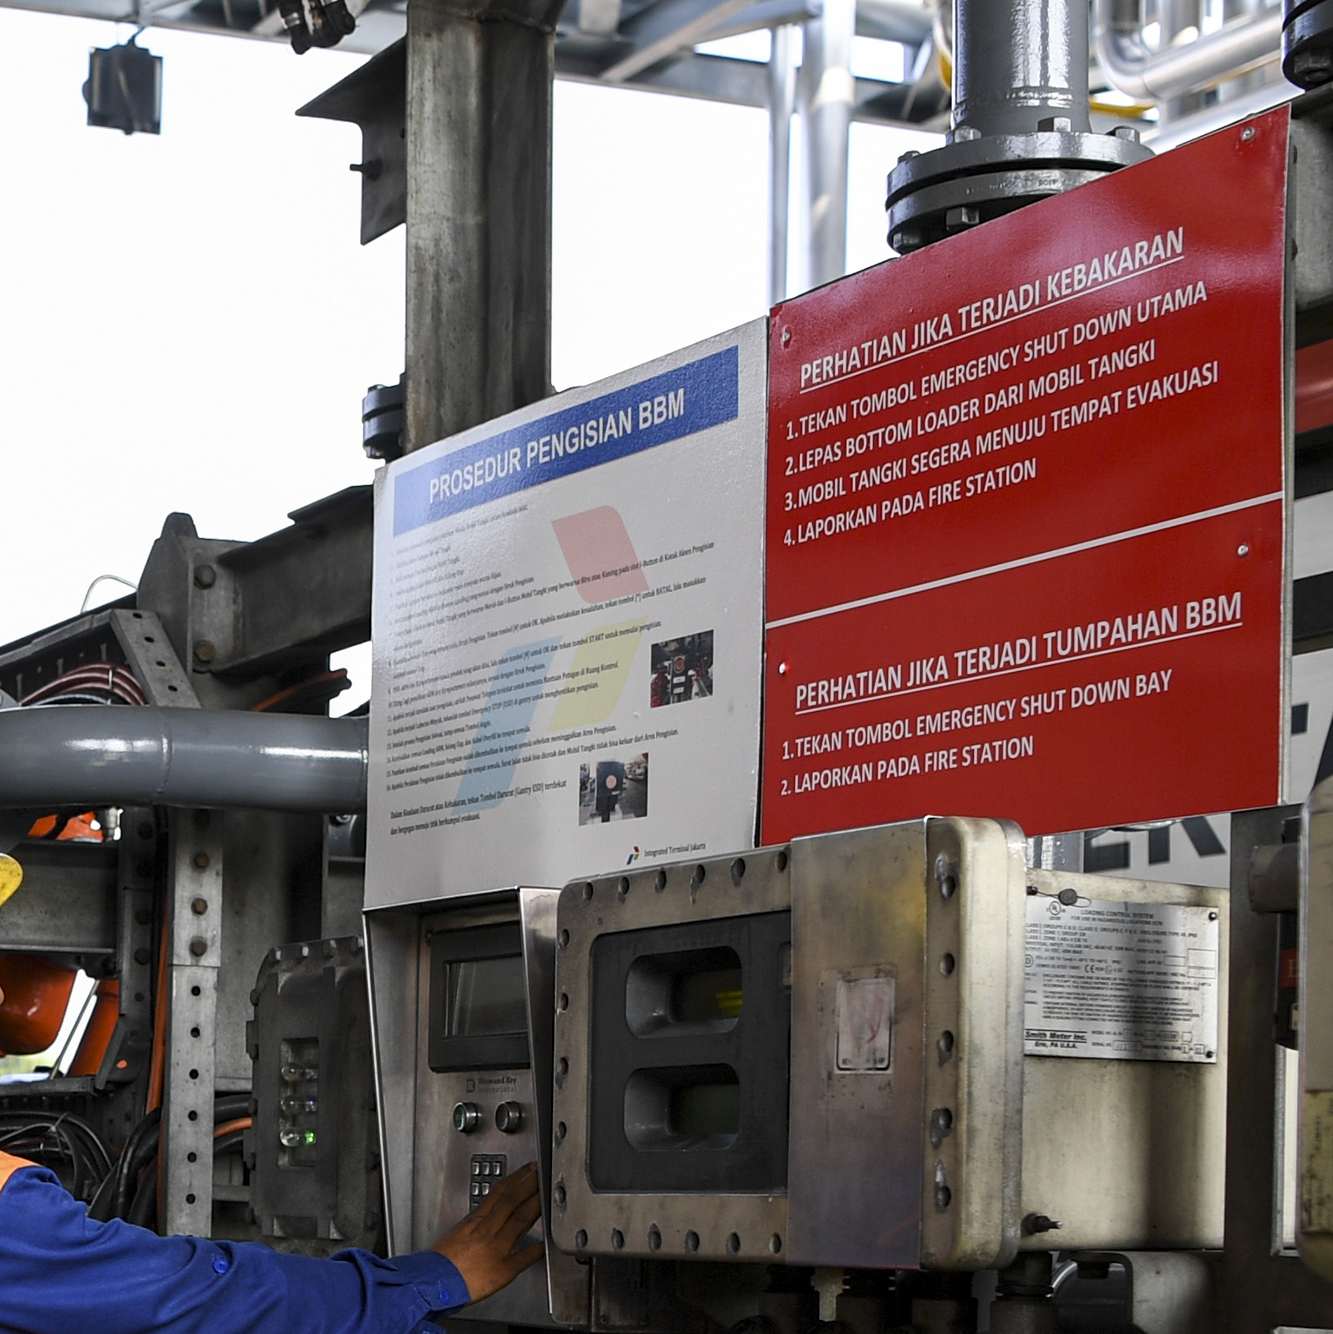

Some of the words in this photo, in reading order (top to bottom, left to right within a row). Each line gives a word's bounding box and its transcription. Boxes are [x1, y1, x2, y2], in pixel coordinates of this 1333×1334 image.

[799, 403, 847, 436] TEKAN
[850, 380, 917, 419] TOMBOL
[921, 344, 1020, 397] EMERGENCY
[1024, 328, 1069, 362] SHUT
[1073, 306, 1131, 345] DOWN
[1137, 280, 1207, 322] UTAMA
[801, 329, 906, 388] PERHATIAN
[911, 313, 953, 350] JIKA
[958, 280, 1040, 332] TERJADI
[1047, 226, 1183, 301] KEBAKARAN
[429, 446, 522, 504] PROSEDUR
[526, 407, 632, 468] PENGISIAN
[638, 388, 684, 430] BBM
[798, 477, 846, 508] MOBIL
[849, 458, 907, 492] TANGKI
[911, 439, 972, 475] SEGERA
[976, 415, 1046, 456] MENUJU
[1050, 390, 1122, 432] TEMPAT
[1127, 360, 1218, 409] EVAKUASI
[799, 441, 842, 472] LEPAS
[846, 419, 912, 458] BOTTOM
[917, 398, 980, 436] LOADER
[984, 383, 1023, 414] DARI
[1028, 364, 1084, 400] MOBIL
[1088, 339, 1155, 380] TANGKI
[798, 503, 877, 543] LAPORKAN
[882, 491, 925, 521] PADA
[929, 479, 962, 508] FIRE
[965, 457, 1036, 497] STATION
[796, 664, 902, 708] PERHATIAN
[906, 655, 949, 687] JIKA
[954, 636, 1036, 677] TERJADI
[1043, 605, 1181, 658] TUMPAHAN
[1186, 591, 1243, 629] BBM
[794, 763, 873, 793] LAPORKAN
[877, 755, 921, 780] PADA
[925, 749, 958, 773] FIRE
[962, 738, 1033, 767] STATION
[795, 731, 842, 757] TEKAN
[845, 718, 912, 748] TOMBOL
[916, 698, 1017, 736] EMERGENCY
[1020, 689, 1067, 717] SHUT
[1071, 677, 1130, 708] DOWN
[1136, 669, 1172, 696] BAY
[1025, 1031, 1047, 1039] Smith
[1049, 1032, 1072, 1040] Meter
